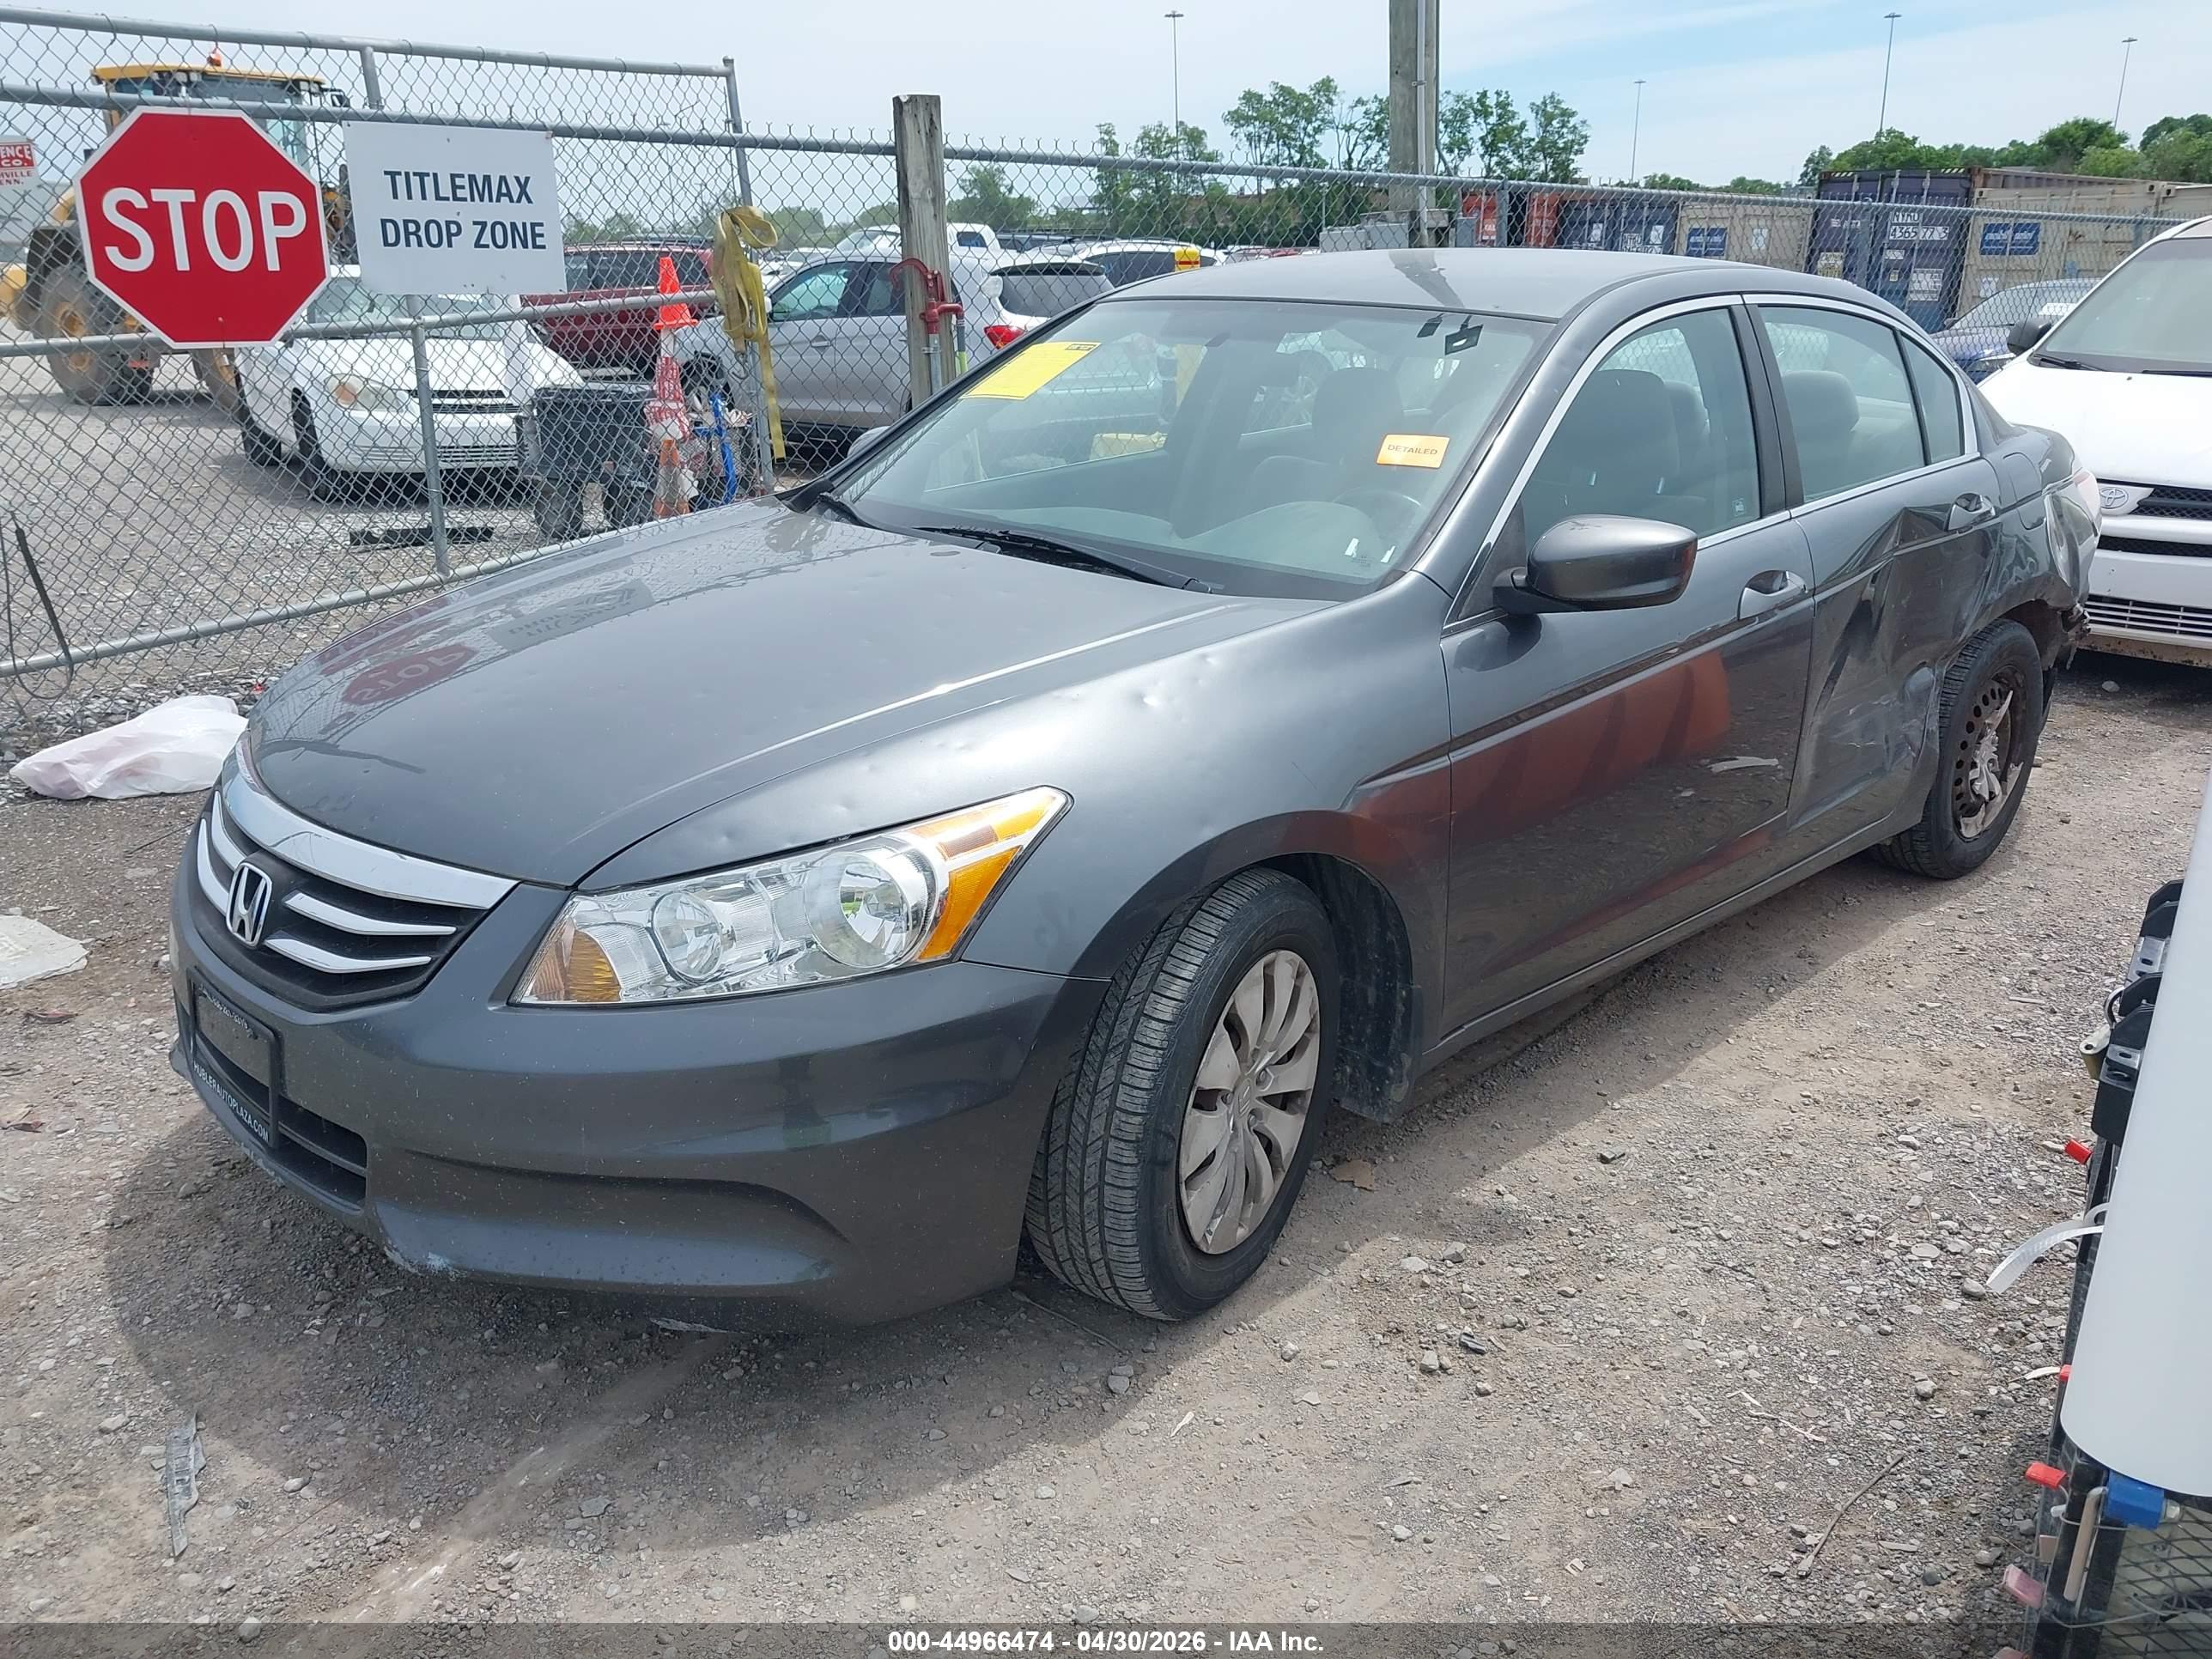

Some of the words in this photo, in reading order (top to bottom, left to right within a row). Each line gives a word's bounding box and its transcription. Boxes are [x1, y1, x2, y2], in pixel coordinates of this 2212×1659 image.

[383, 170, 533, 204] TITLEMAX
[102, 186, 307, 272] STOP
[380, 218, 463, 248] DROP
[472, 221, 547, 249] ZONE
[1388, 444, 1438, 455] DETAILED
[193, 1060, 269, 1143] HUBLERAUTOPLAZA.COM
